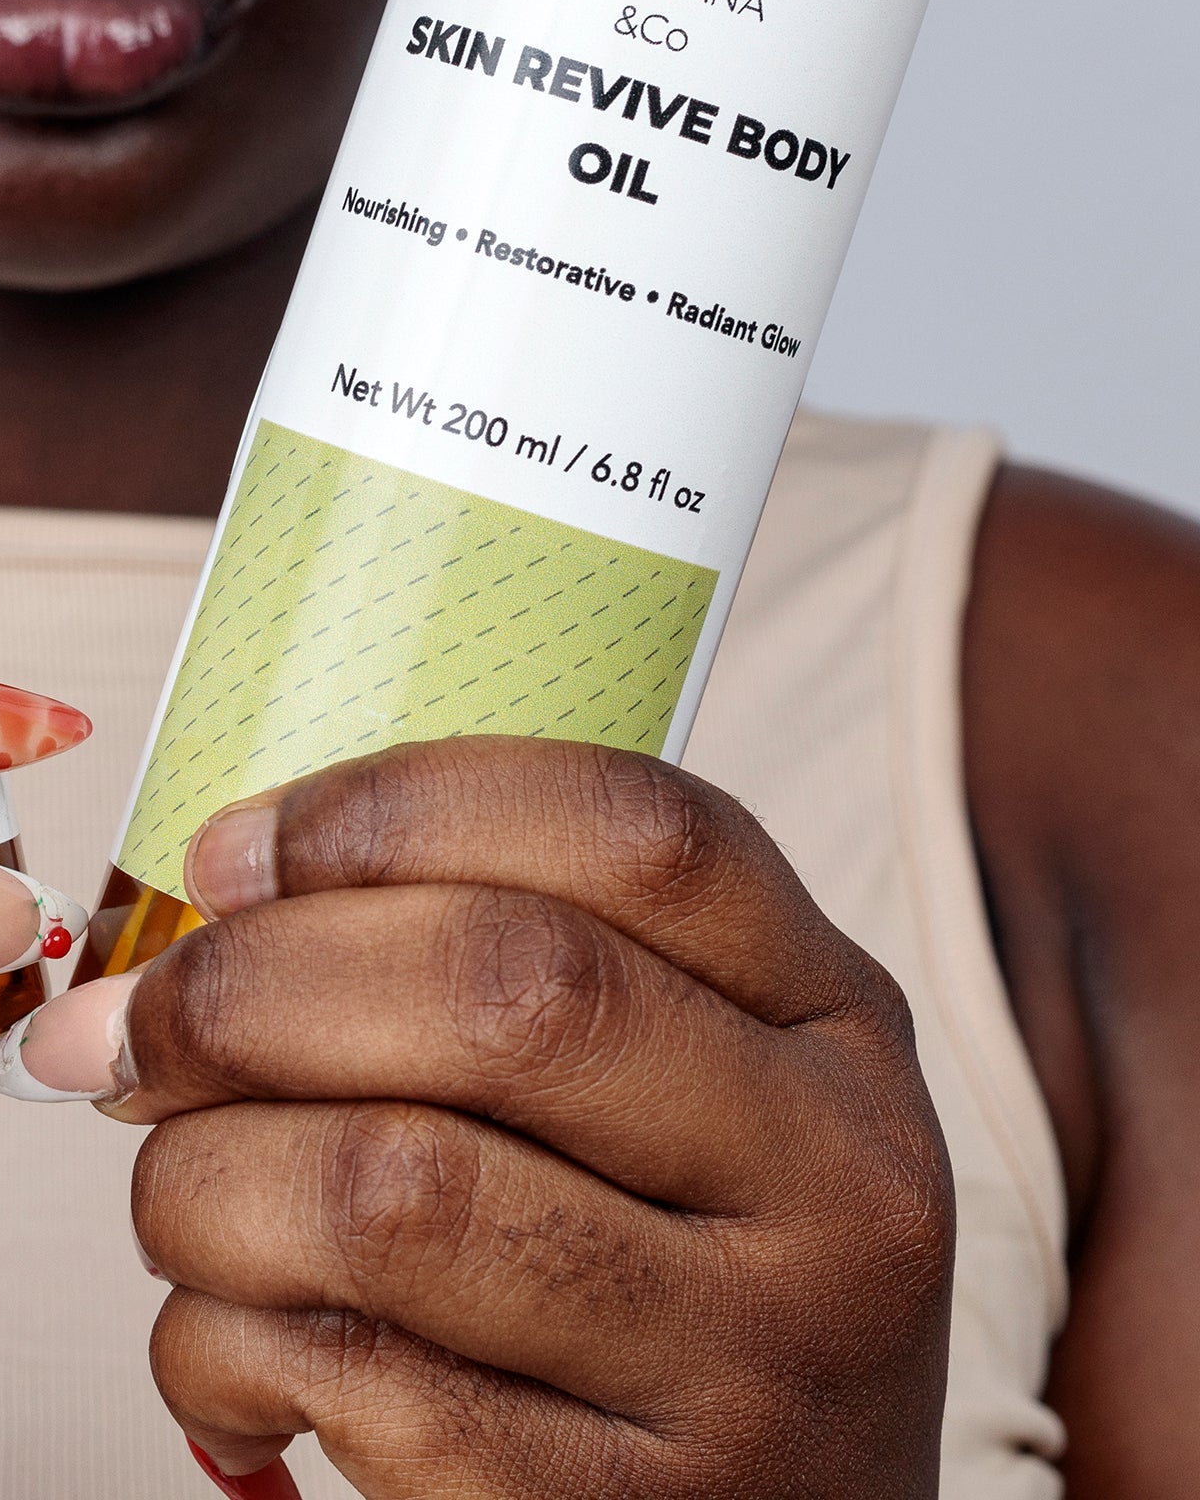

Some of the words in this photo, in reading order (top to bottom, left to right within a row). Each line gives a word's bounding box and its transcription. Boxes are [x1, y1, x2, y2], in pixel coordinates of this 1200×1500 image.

[405, 16, 506, 76] SKIN
[513, 45, 720, 145] REVIVE
[726, 113, 851, 190] BODY
[614, 5, 688, 52] &Co
[568, 142, 659, 205] OIL
[342, 186, 447, 246] Nourishing
[475, 229, 636, 302] Restorative
[666, 291, 758, 344] Radiant
[760, 323, 801, 358] Glow
[331, 363, 383, 407] Net
[392, 382, 437, 425] Wt
[442, 403, 508, 447] 200
[515, 434, 562, 466] ml
[563, 444, 588, 473] /
[591, 453, 643, 492] 6.8
[648, 468, 671, 502] fl
[674, 486, 706, 514] oz
